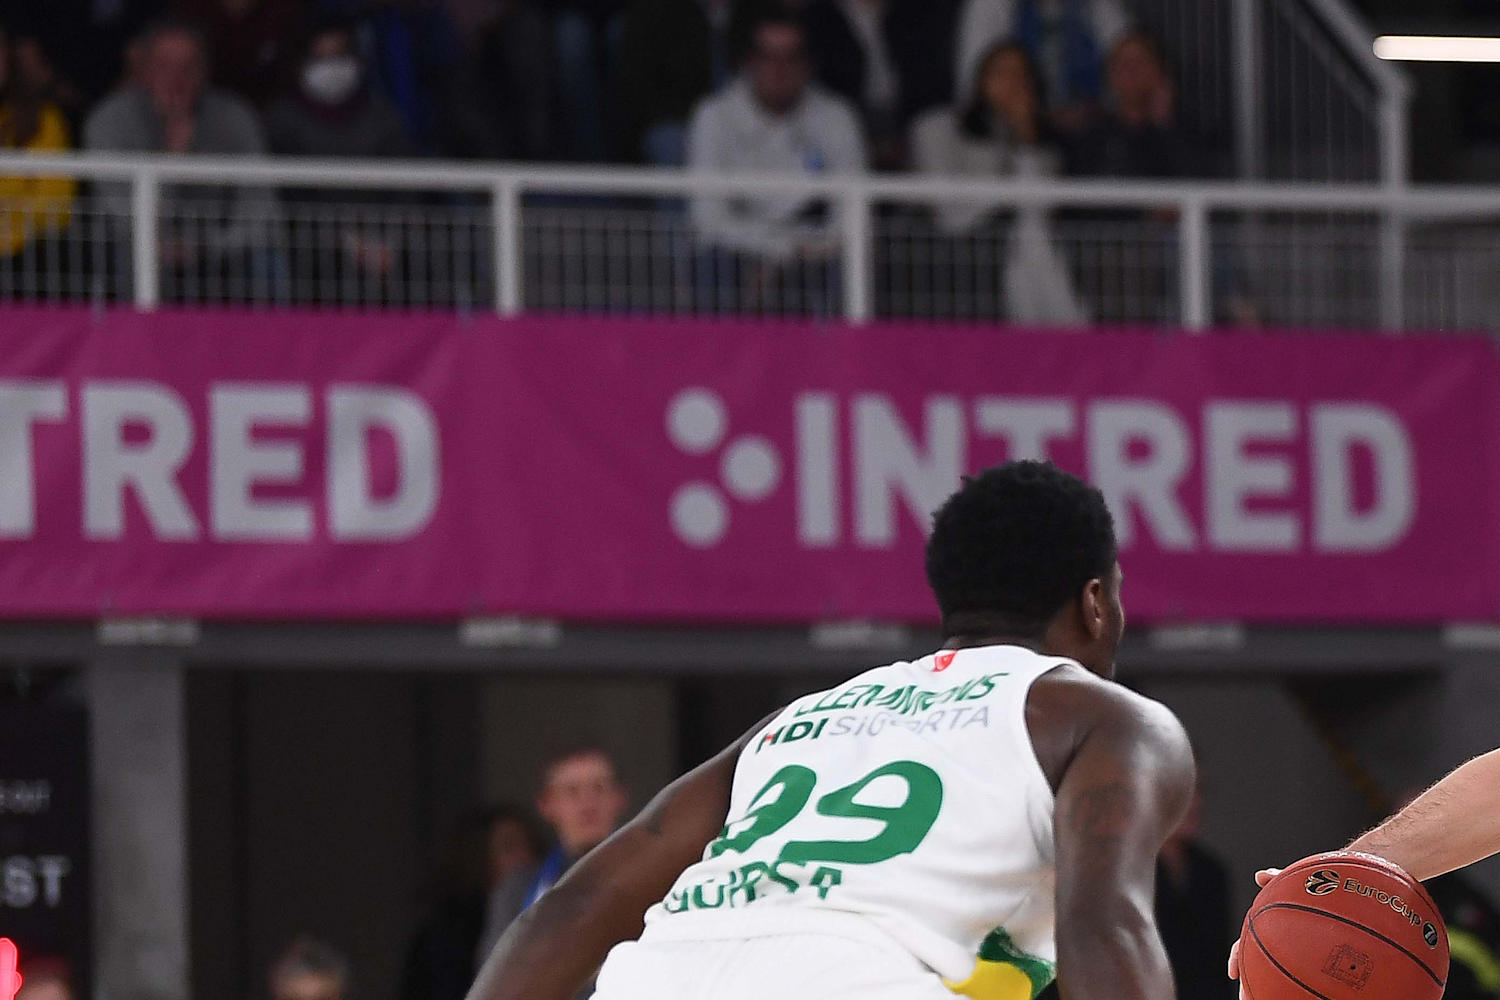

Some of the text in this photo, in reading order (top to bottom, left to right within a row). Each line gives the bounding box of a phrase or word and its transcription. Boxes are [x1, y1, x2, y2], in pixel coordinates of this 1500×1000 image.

[795, 393, 1414, 553] INTRED
[755, 718, 829, 753] HDI
[1343, 877, 1422, 927] EuroCup
